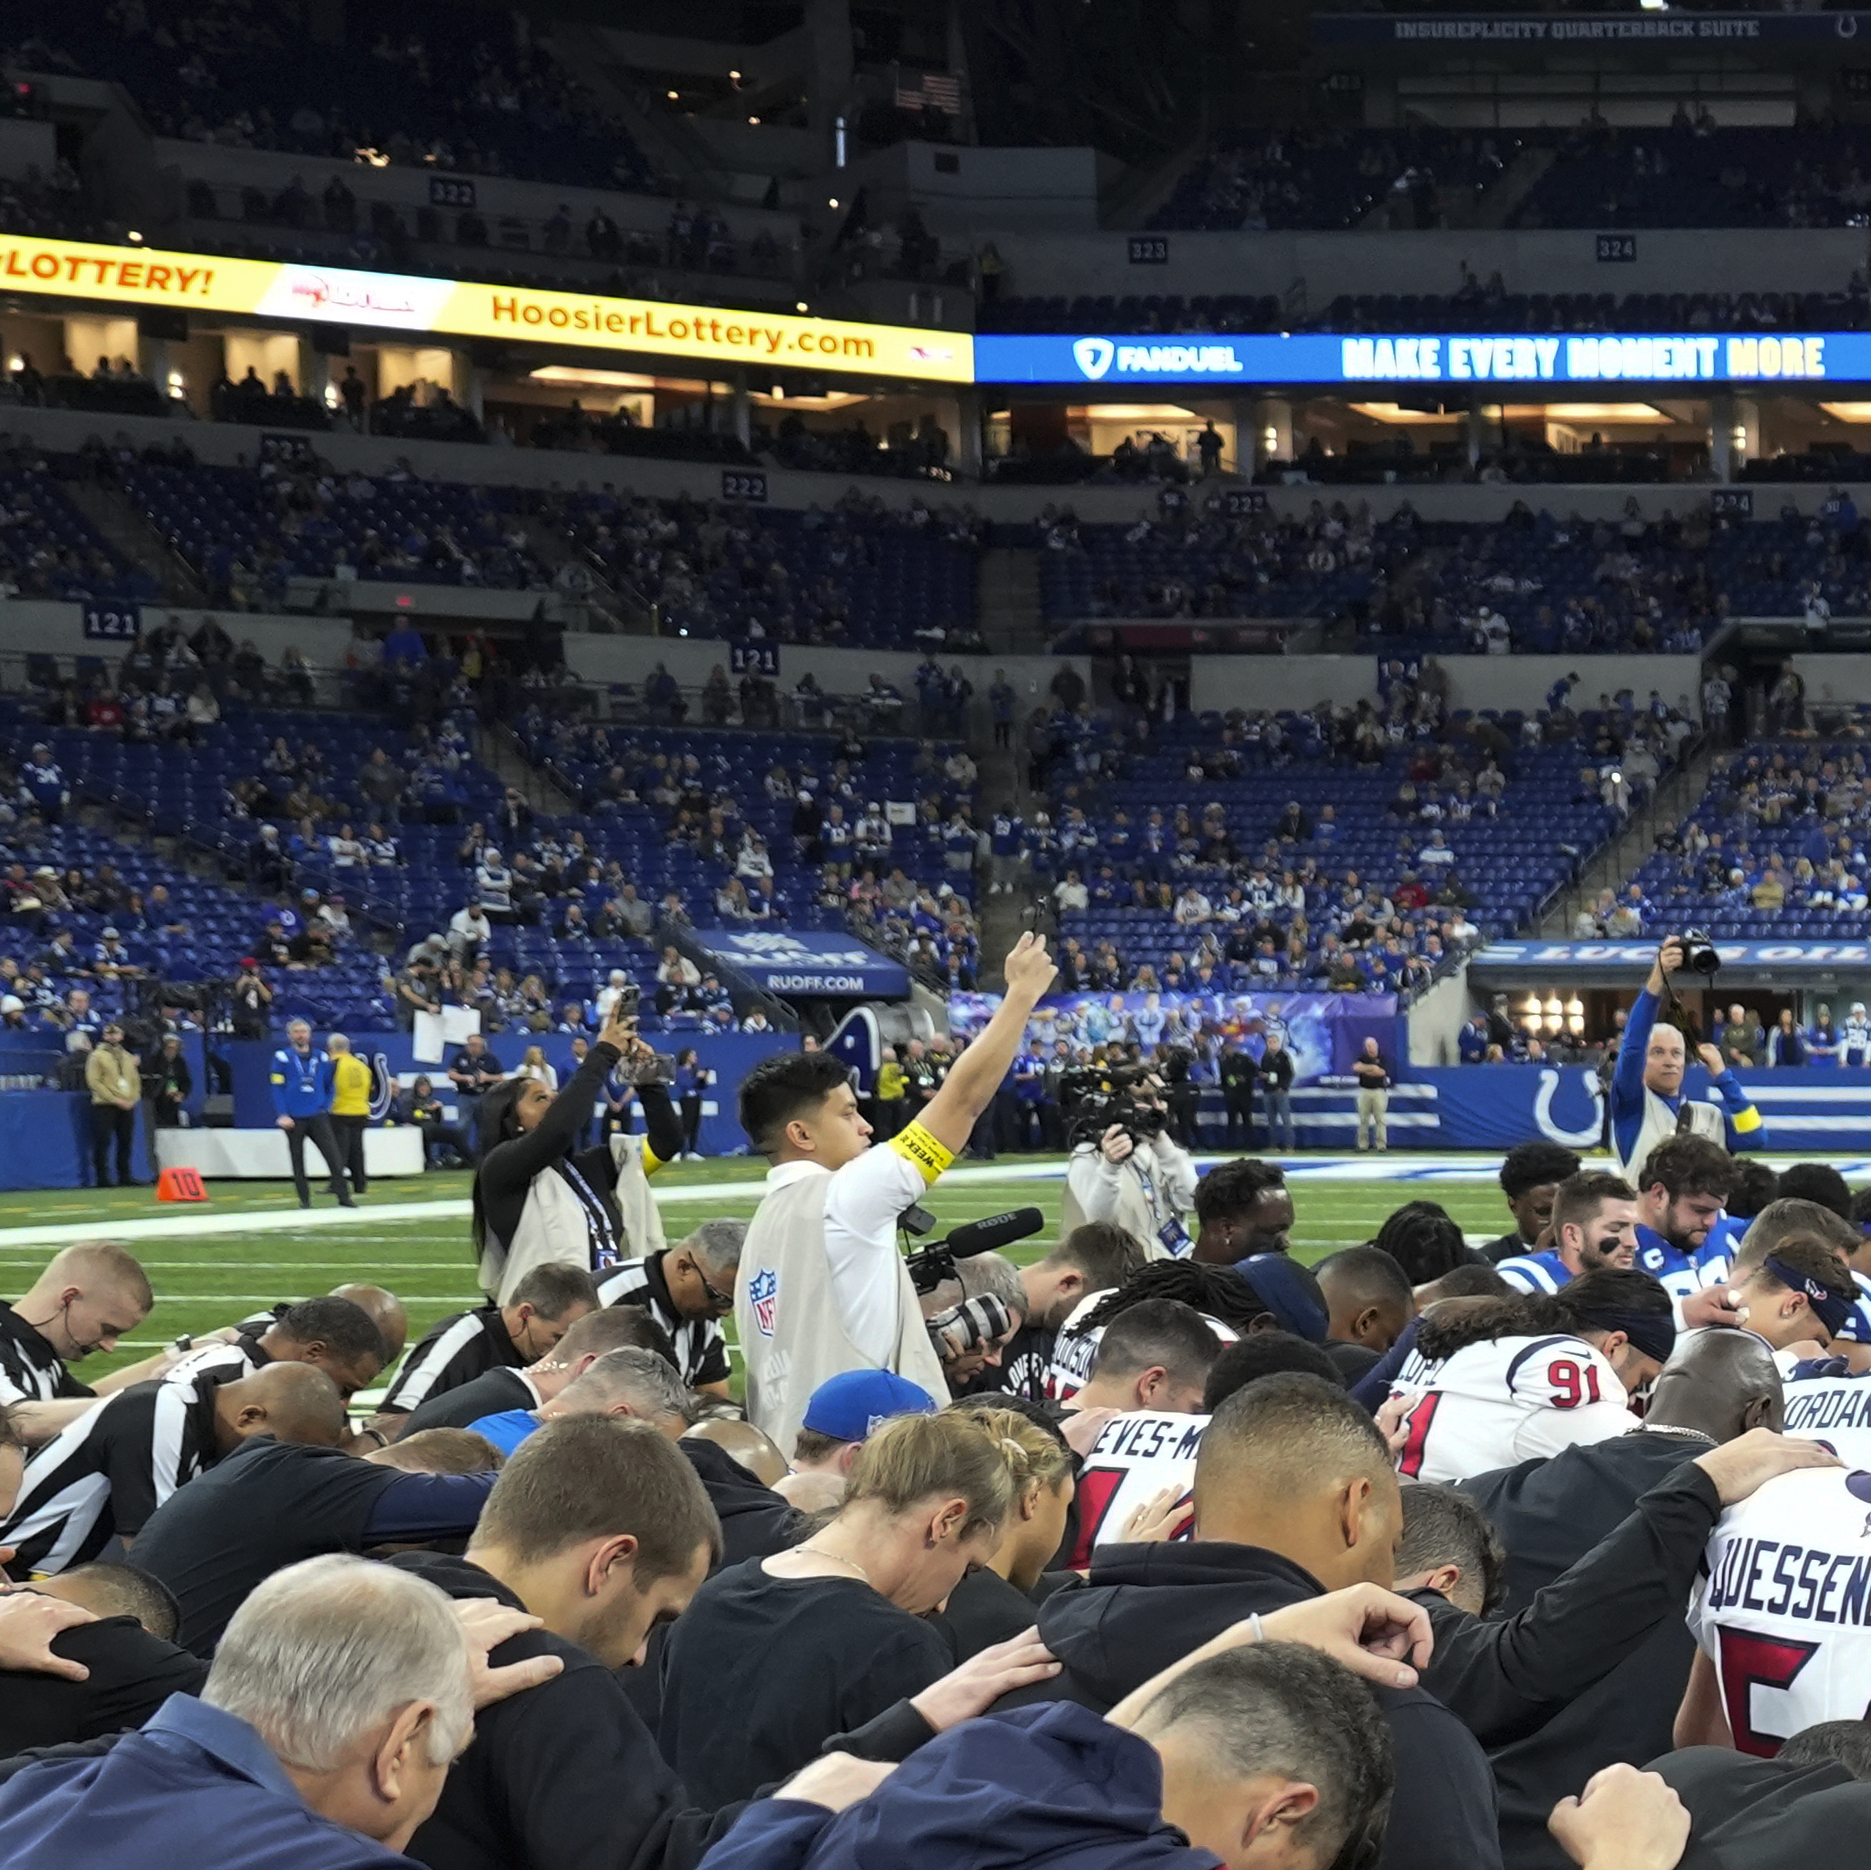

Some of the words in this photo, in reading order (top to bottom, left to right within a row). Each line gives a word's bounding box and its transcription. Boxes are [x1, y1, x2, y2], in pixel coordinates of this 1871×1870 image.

[1551, 22, 1695, 39] QUARTERBACK
[1700, 21, 1759, 39] SUITE
[1132, 241, 1166, 258] 323
[0, 250, 214, 293] LOTTERY!
[491, 295, 875, 358] HoosierLottery.com
[1117, 345, 1244, 372] FANDUEL
[1340, 338, 1441, 380] MAKE
[1447, 338, 1559, 380] EVERY
[1571, 337, 1718, 379] MOMENT
[1726, 337, 1826, 379] MORE
[727, 477, 765, 496] 222
[87, 614, 135, 634] 121
[735, 648, 775, 669] 121
[1379, 661, 1418, 679] 14
[1533, 944, 1746, 961] LUC
[1755, 945, 1869, 961] OIL
[767, 974, 864, 991] RUOFF.COM
[906, 1139, 936, 1168] WEEK
[172, 1171, 200, 1196] 10
[1548, 1360, 1601, 1408] 91
